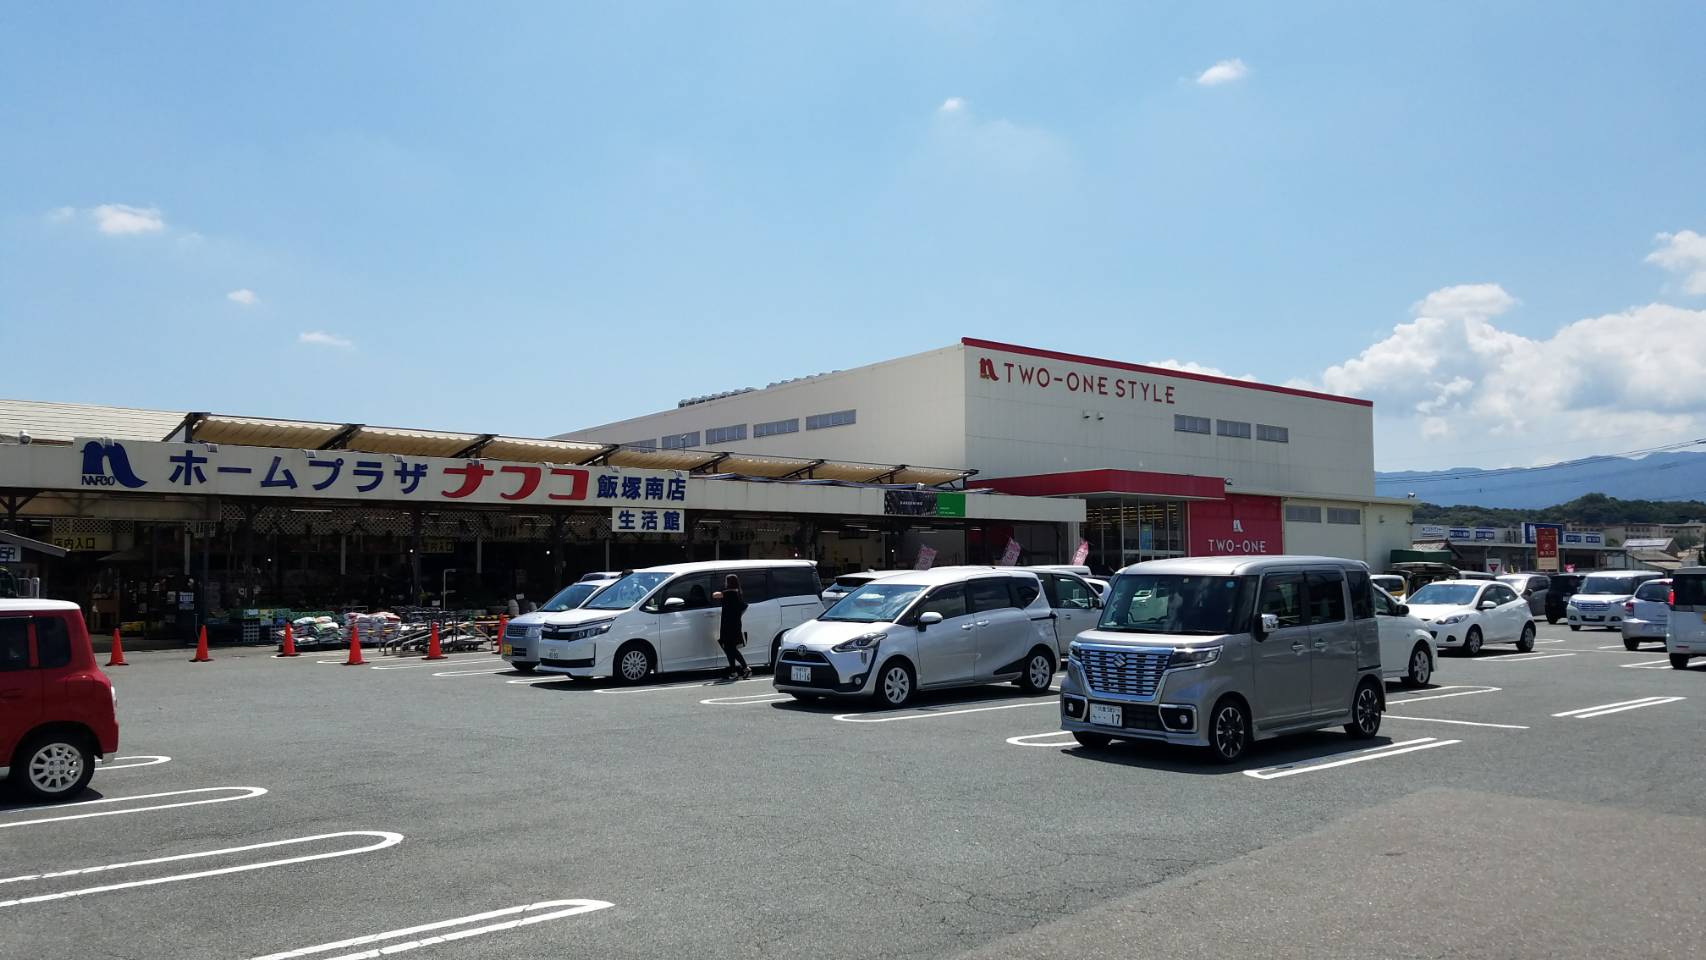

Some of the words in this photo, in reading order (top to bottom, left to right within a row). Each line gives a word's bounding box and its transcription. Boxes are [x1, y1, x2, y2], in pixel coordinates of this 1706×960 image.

[1004, 362, 1108, 395] TWO-ONE
[1115, 378, 1176, 404] STYLE
[81, 475, 116, 487] NAFCO
[170, 449, 427, 494] ホームプラザ
[441, 463, 590, 501] ナフコ
[597, 473, 686, 502] 飯塚南店
[617, 510, 681, 532] 生活館
[1208, 538, 1267, 553] TWO-ONE
